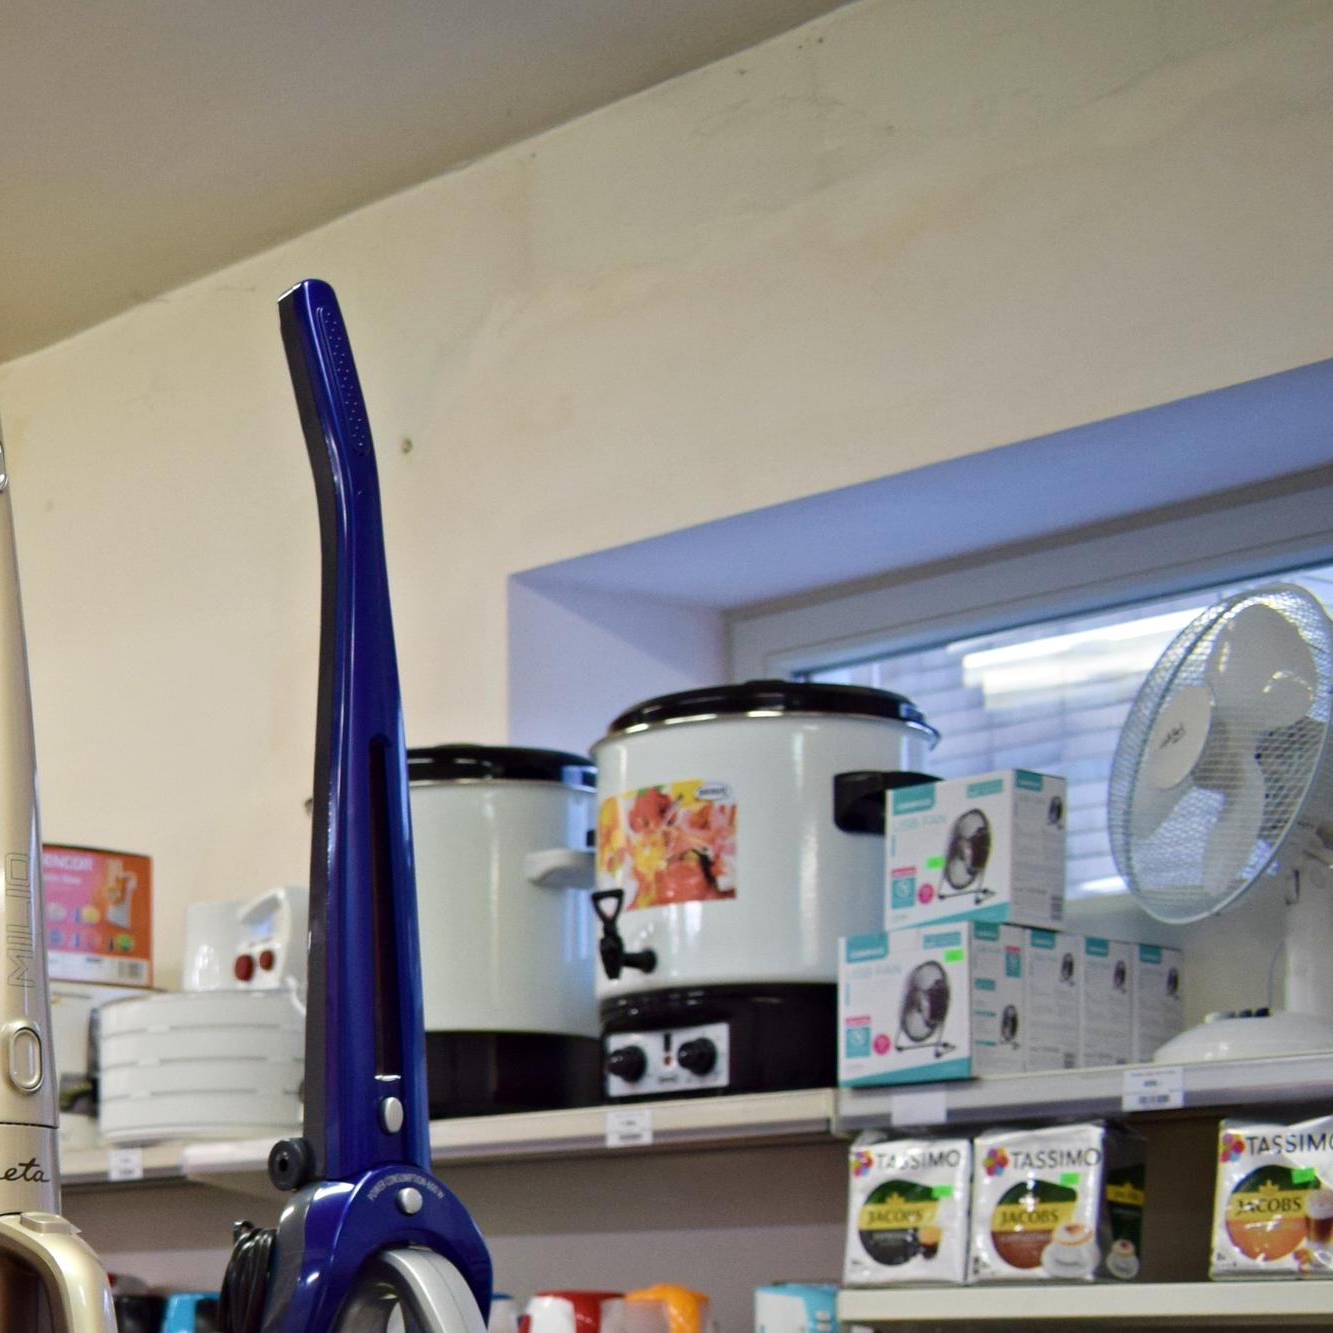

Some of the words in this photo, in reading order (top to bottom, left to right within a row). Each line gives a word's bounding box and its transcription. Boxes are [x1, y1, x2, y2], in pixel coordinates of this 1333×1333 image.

[874, 1148, 961, 1171] TASSIMO
[1012, 1146, 1100, 1169] TASSIMO
[999, 1206, 1059, 1225] JACOBS
[1235, 1195, 1303, 1216] JACOBS
